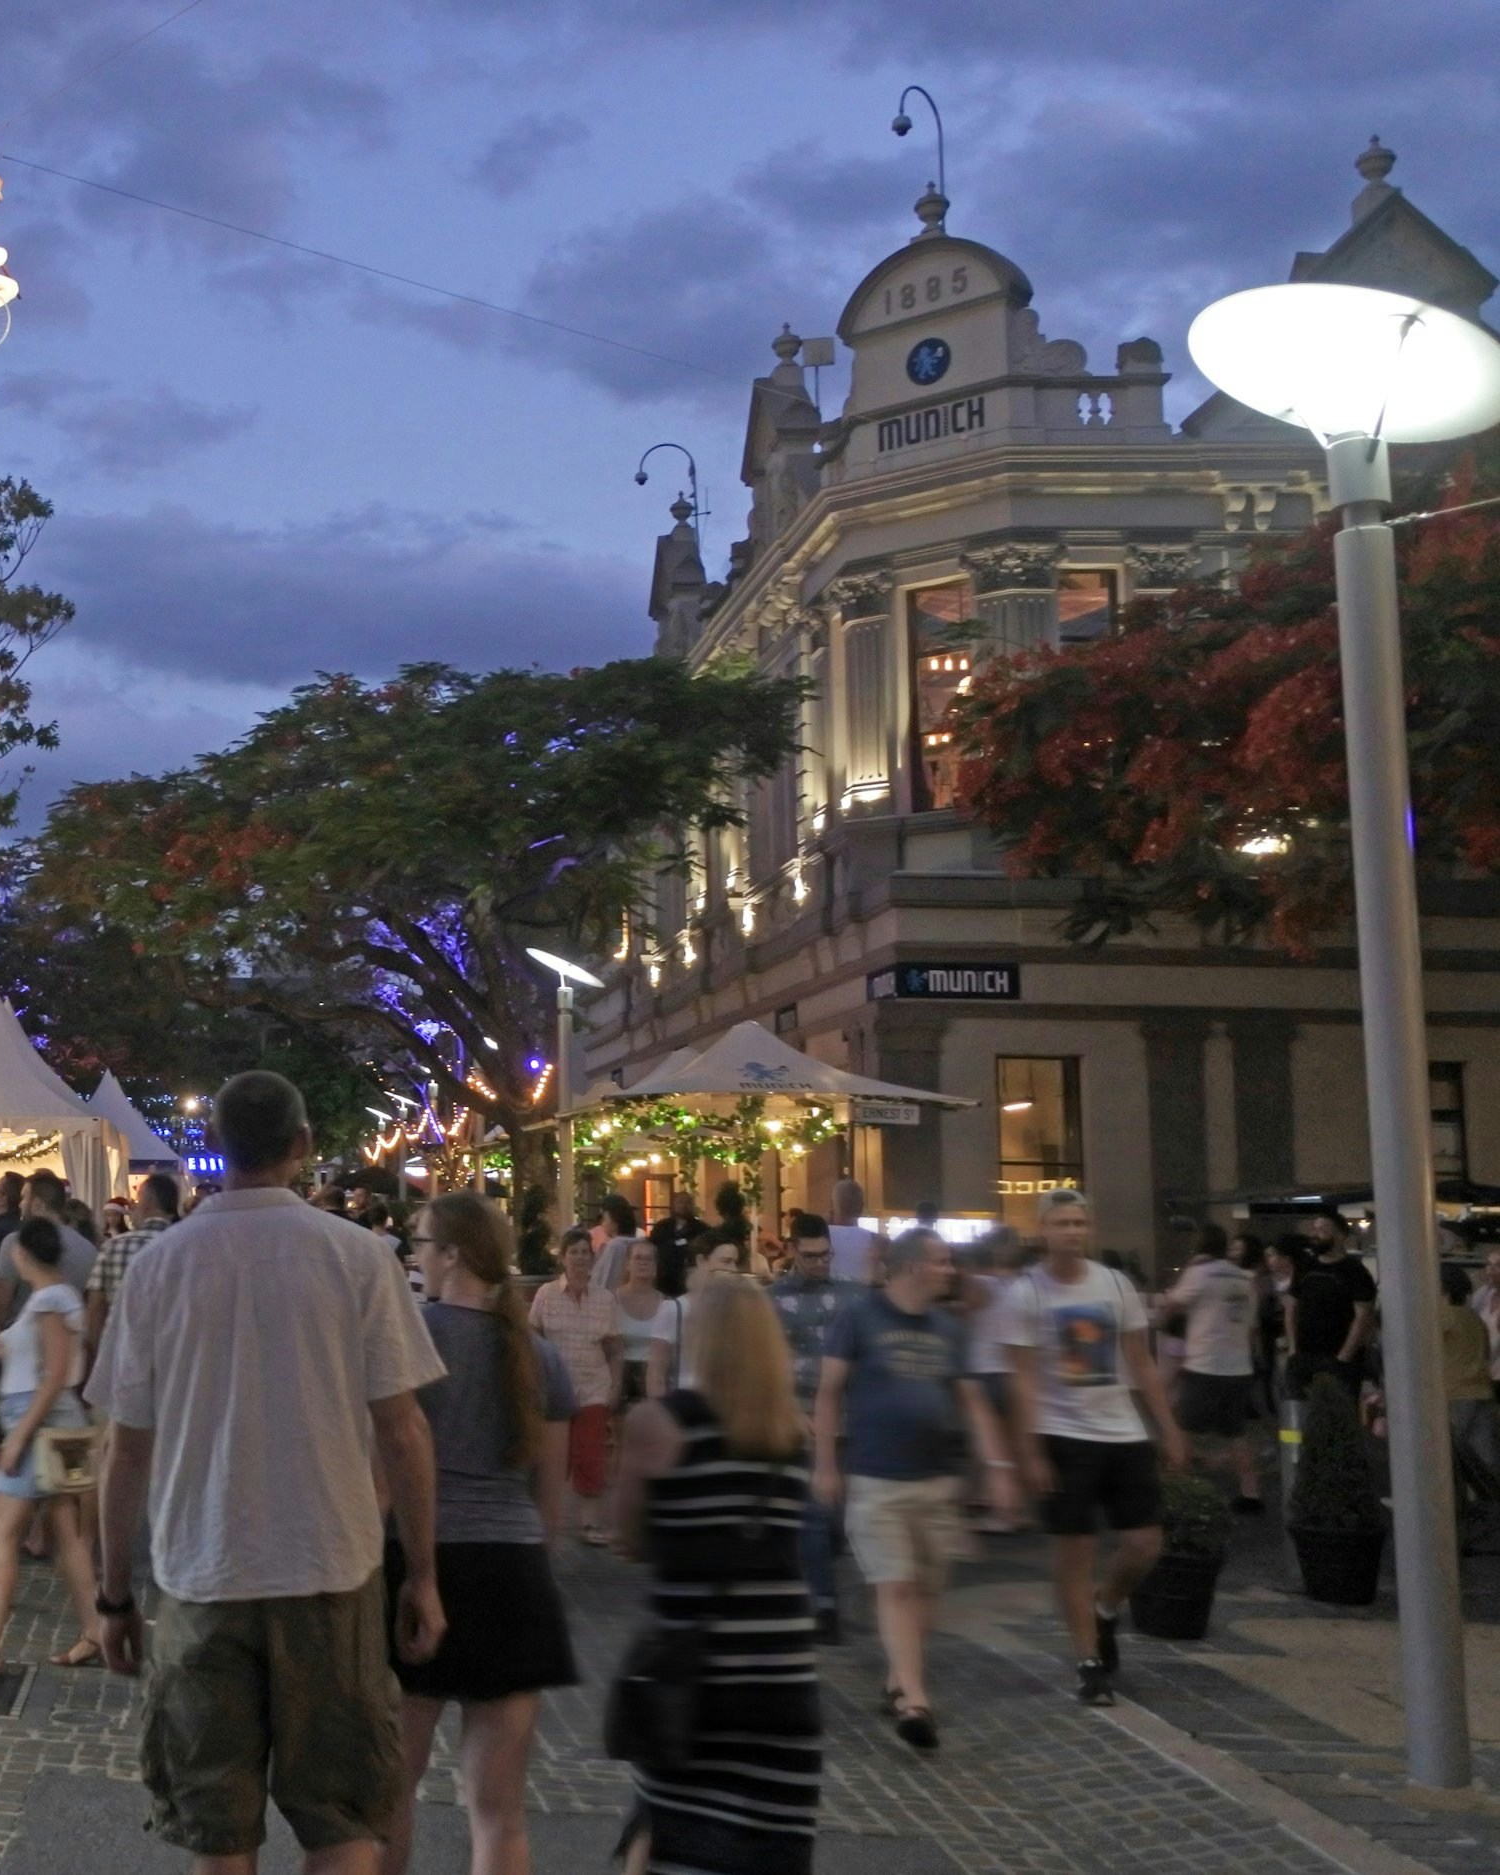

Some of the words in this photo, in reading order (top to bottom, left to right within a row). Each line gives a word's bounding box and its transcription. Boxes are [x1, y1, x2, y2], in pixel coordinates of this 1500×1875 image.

[884, 266, 968, 315] 1885
[878, 396, 985, 452] MUNICH
[928, 969, 1009, 993] MUNICH
[862, 1107, 900, 1119] ERNEST
